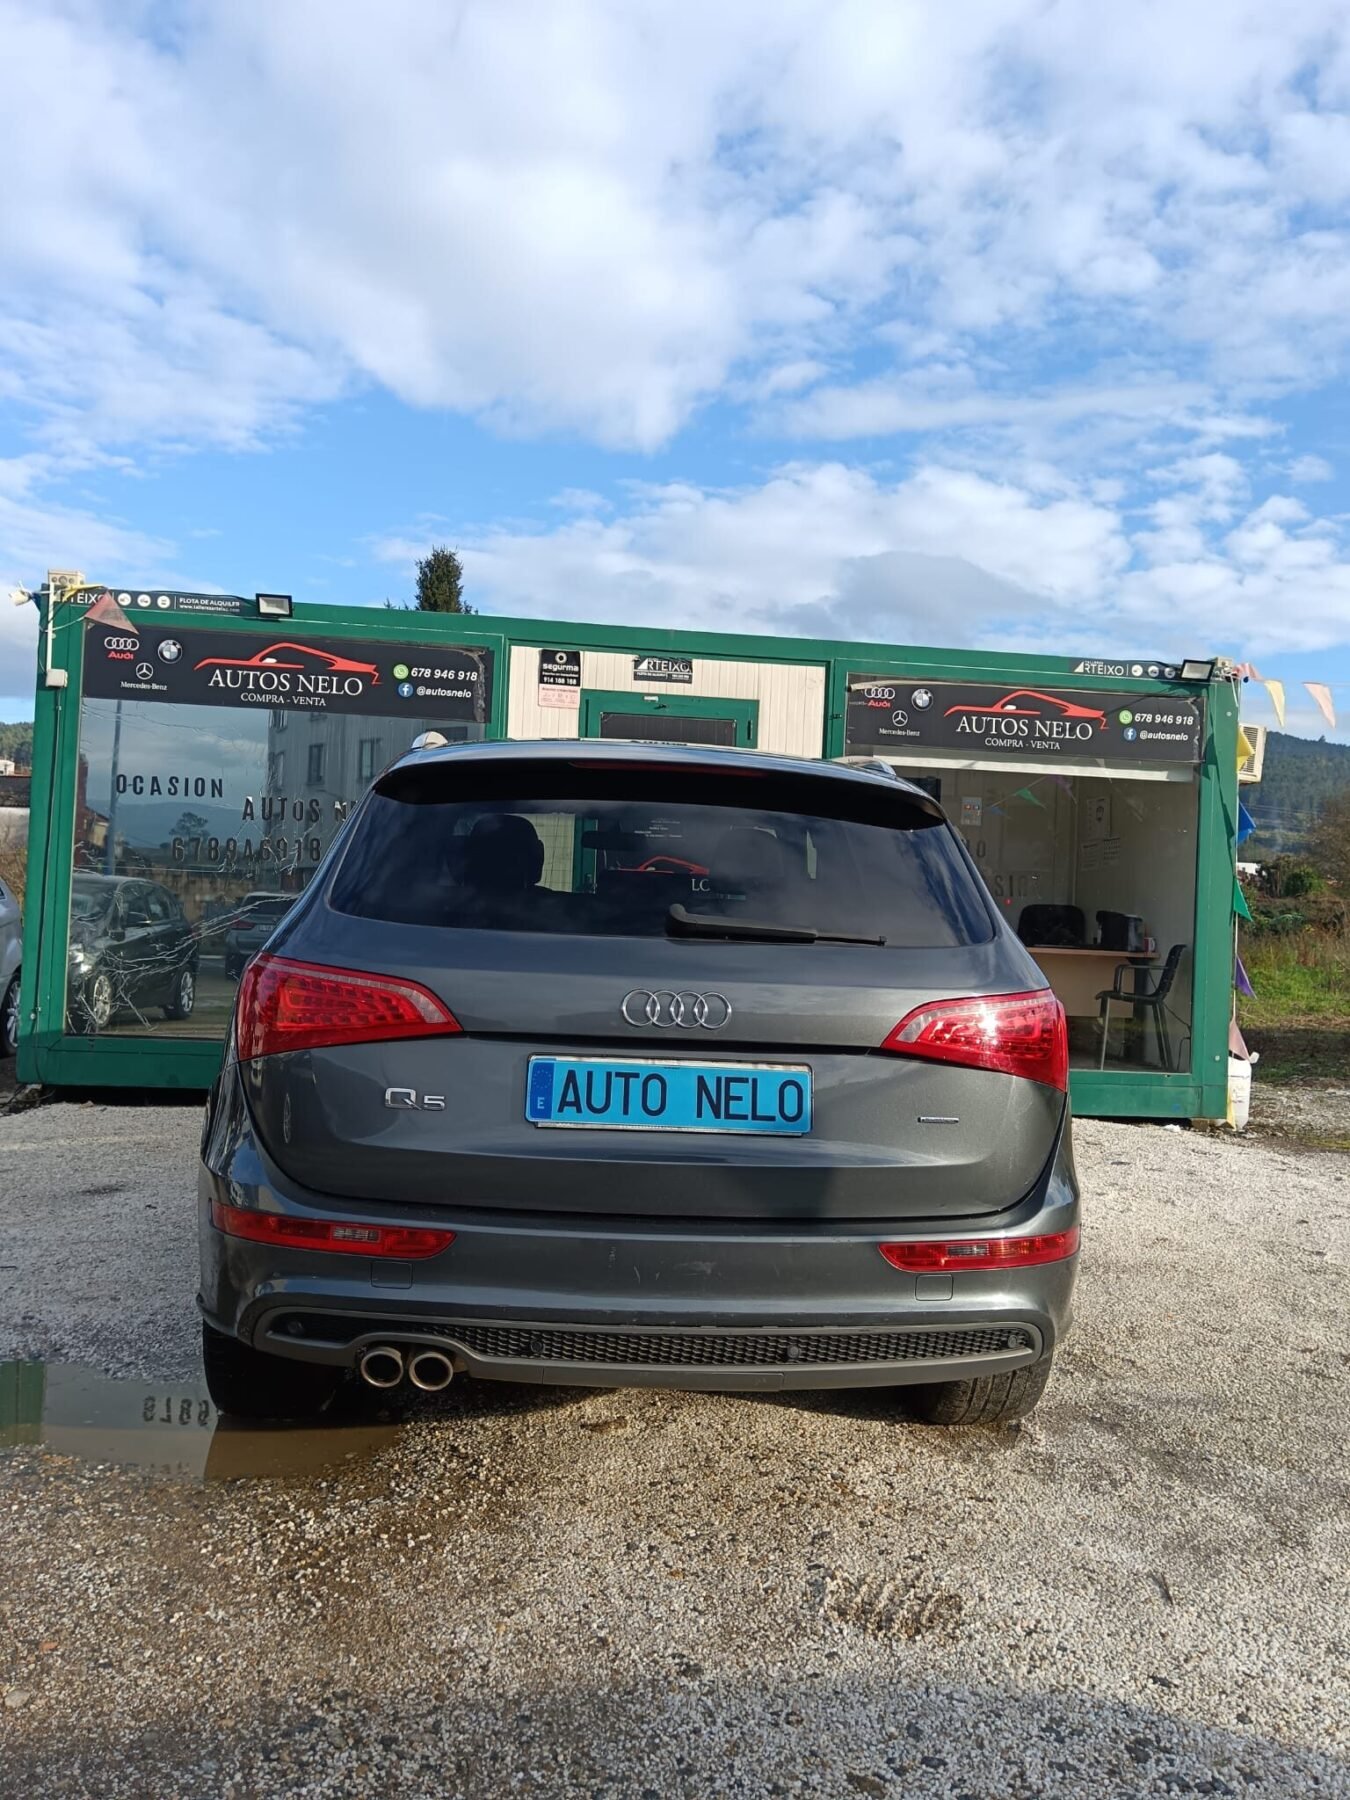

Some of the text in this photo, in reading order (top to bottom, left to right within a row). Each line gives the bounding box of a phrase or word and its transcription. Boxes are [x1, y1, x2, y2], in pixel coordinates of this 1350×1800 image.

[107, 651, 135, 660] Audi
[542, 663, 580, 672] segurma
[637, 658, 691, 672] ARTEIXO
[1073, 661, 1125, 676] ARTEIXO
[411, 667, 478, 681] 678 946 918
[120, 681, 168, 691] Mercedes-Benz
[208, 668, 363, 696] AUTOS NELO
[416, 685, 472, 698] @autosnelo
[240, 692, 284, 704] COMPRA
[292, 696, 326, 706] VENTA
[867, 700, 891, 708] Audi
[1134, 713, 1194, 725] 678 946 918
[879, 727, 921, 737] Mercedes-Benz
[956, 715, 1093, 741] AUTOS NELO
[1139, 730, 1189, 741] @autosnelo
[984, 737, 1024, 748] COMPRA
[1030, 740, 1061, 750] VENTA
[116, 774, 223, 798] OCASION
[242, 796, 320, 823] AUTOS
[385, 1087, 445, 1111] Q5
[537, 1096, 545, 1109] E
[557, 1069, 804, 1123] AUTO NELO
